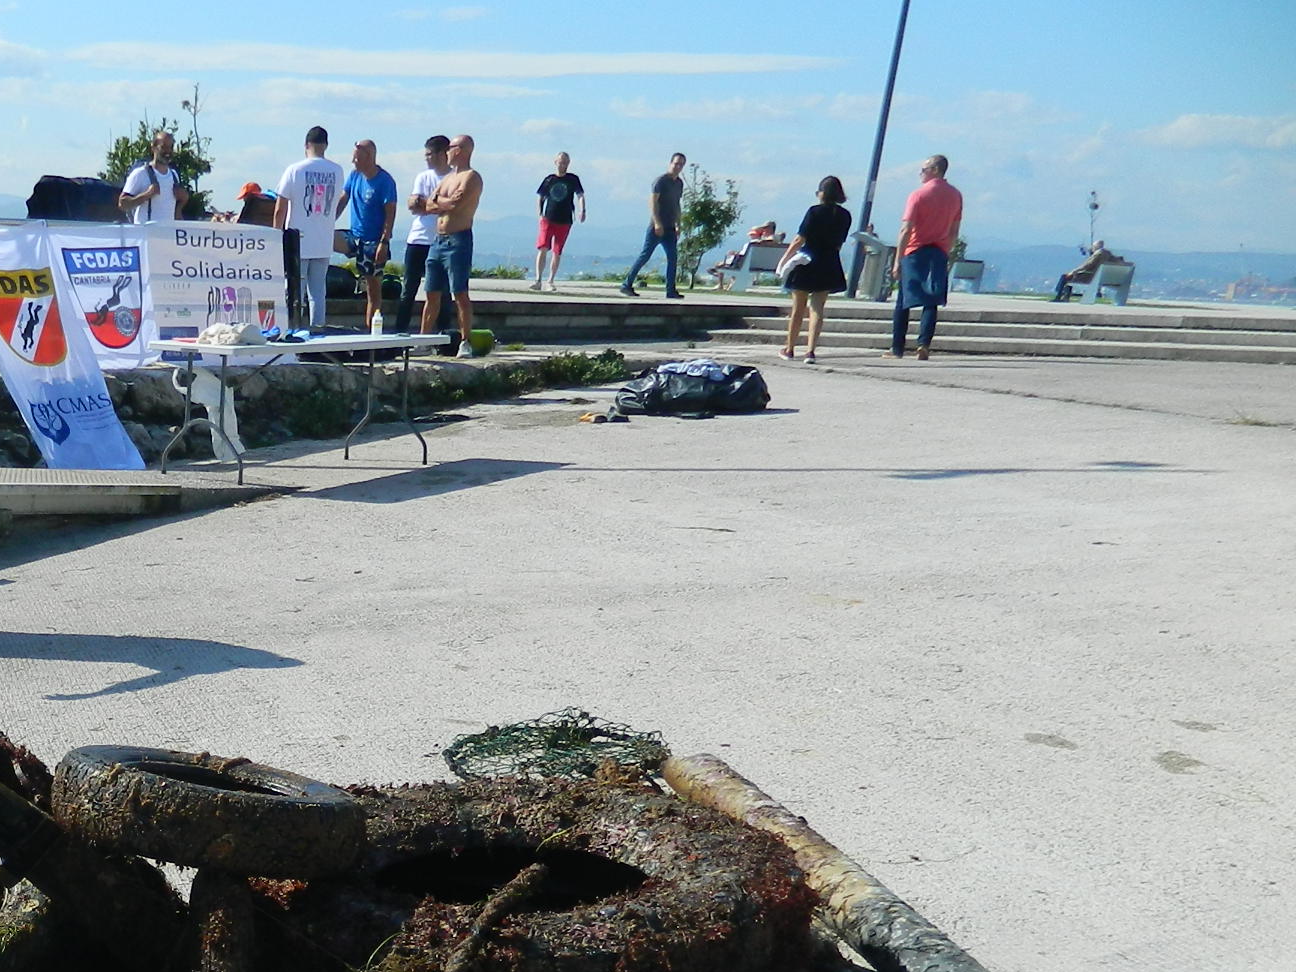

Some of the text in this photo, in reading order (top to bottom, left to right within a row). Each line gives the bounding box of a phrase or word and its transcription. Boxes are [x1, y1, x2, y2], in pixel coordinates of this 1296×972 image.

[176, 229, 265, 254] Burbujas
[71, 251, 132, 268] FCDAS
[74, 275, 110, 285] CANTABRIA
[172, 260, 273, 280] Solidarias
[57, 393, 111, 414] CMAS
